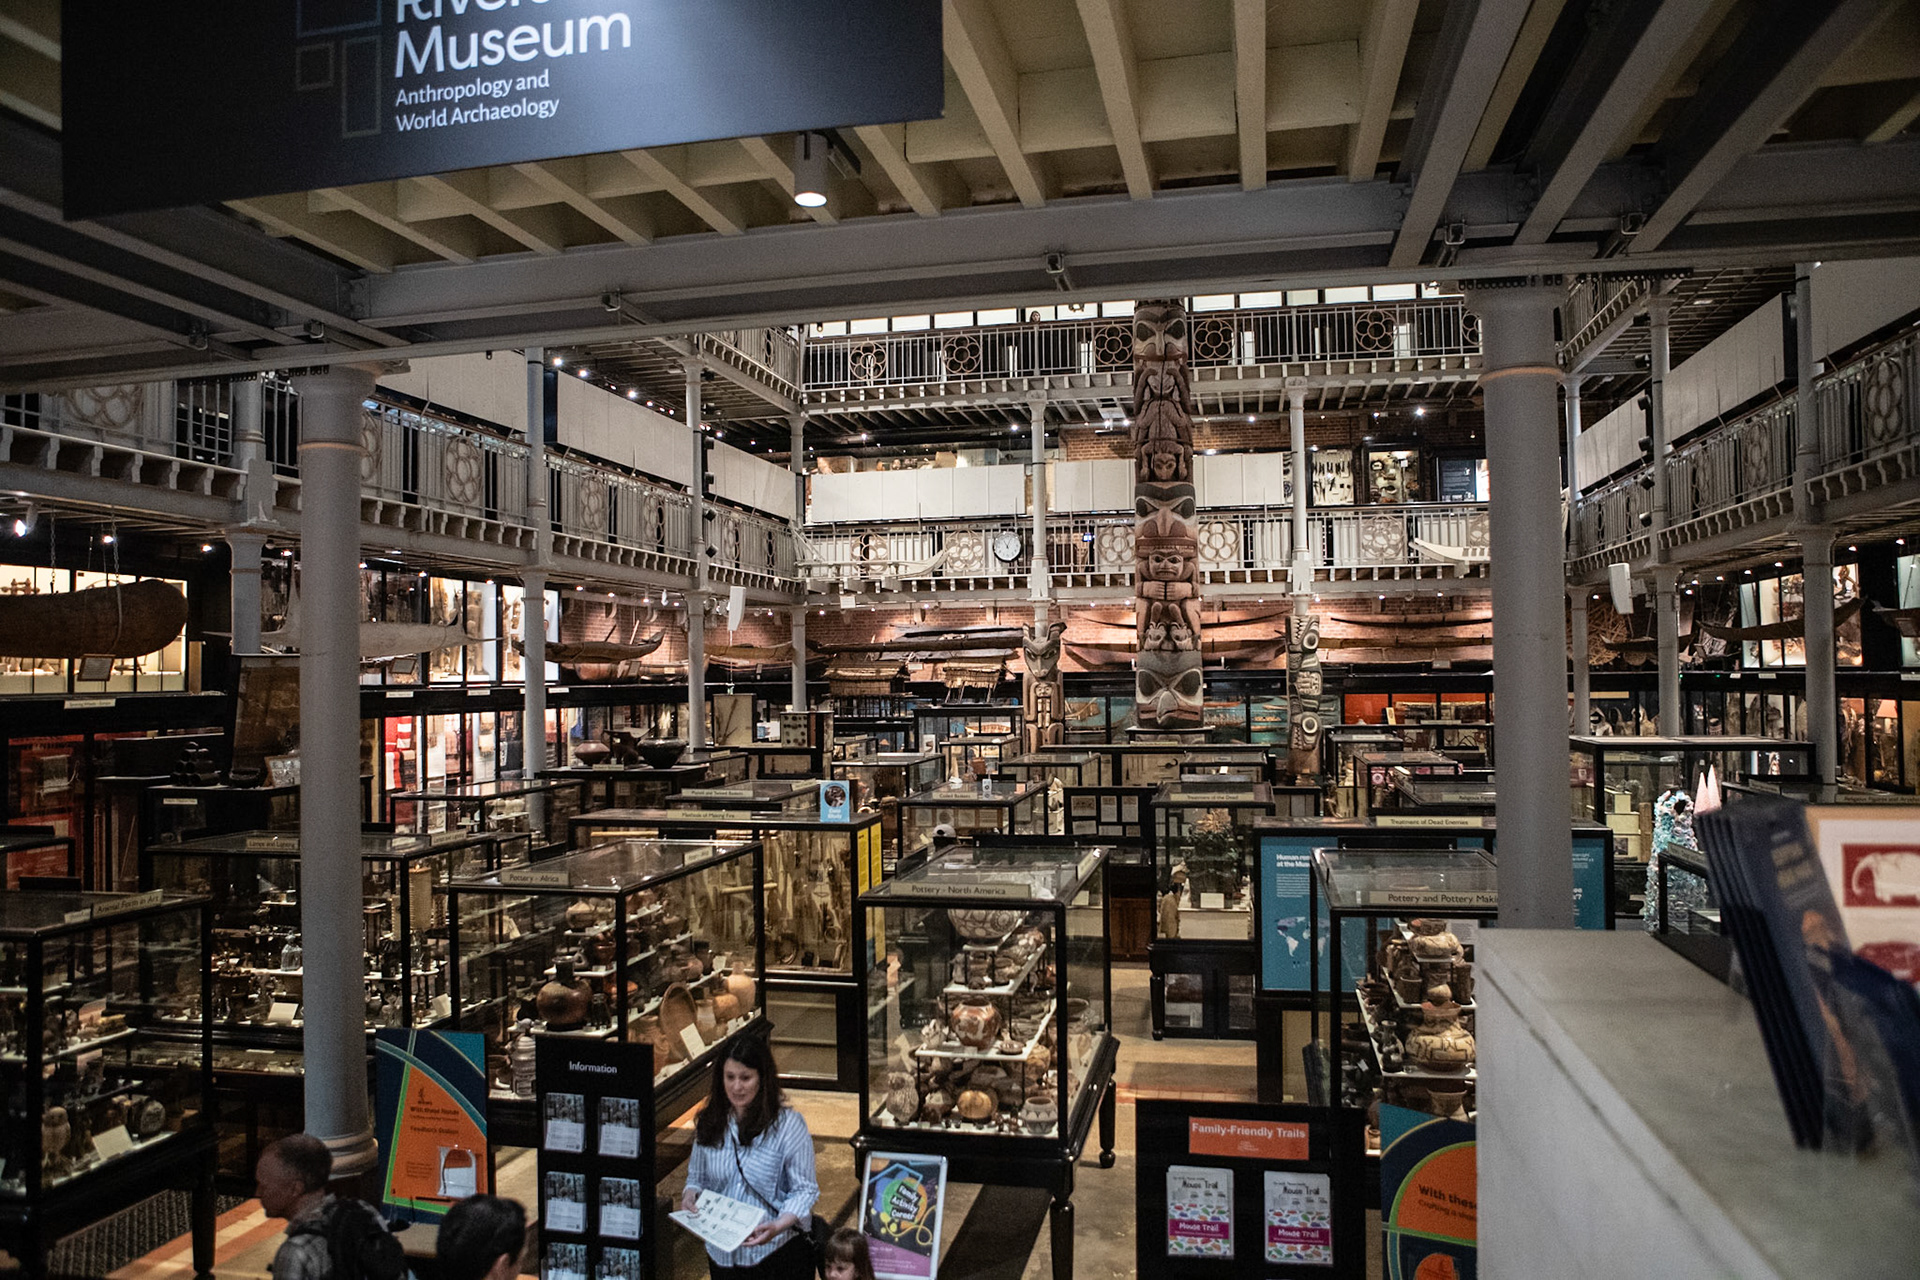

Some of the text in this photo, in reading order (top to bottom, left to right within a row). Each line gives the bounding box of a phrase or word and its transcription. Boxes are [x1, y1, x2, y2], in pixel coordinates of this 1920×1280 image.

[395, 12, 631, 78] Museum
[395, 69, 550, 107] Anthropology and
[395, 98, 560, 132] World Archaeology
[1390, 818, 1469, 826] Treatment of Dead Enemies
[509, 873, 533, 884] Pottery
[540, 873, 559, 882] Africa
[912, 885, 940, 896] Pottery
[947, 885, 972, 895] North
[974, 886, 1006, 895] America
[147, 895, 160, 904] Art
[1388, 893, 1421, 905] Pottery
[1422, 894, 1438, 903] and
[1440, 894, 1474, 905] Pottery
[568, 1060, 618, 1074] Information
[1191, 1122, 1306, 1140] Family-Friendly Trails
[898, 1185, 918, 1204] Family
[1418, 1183, 1446, 1201] With
[891, 1195, 918, 1213] Activity
[891, 1208, 916, 1221] Corner
[1178, 1221, 1220, 1233] Mouse Trail
[1277, 1228, 1320, 1238] Mouse Trail
